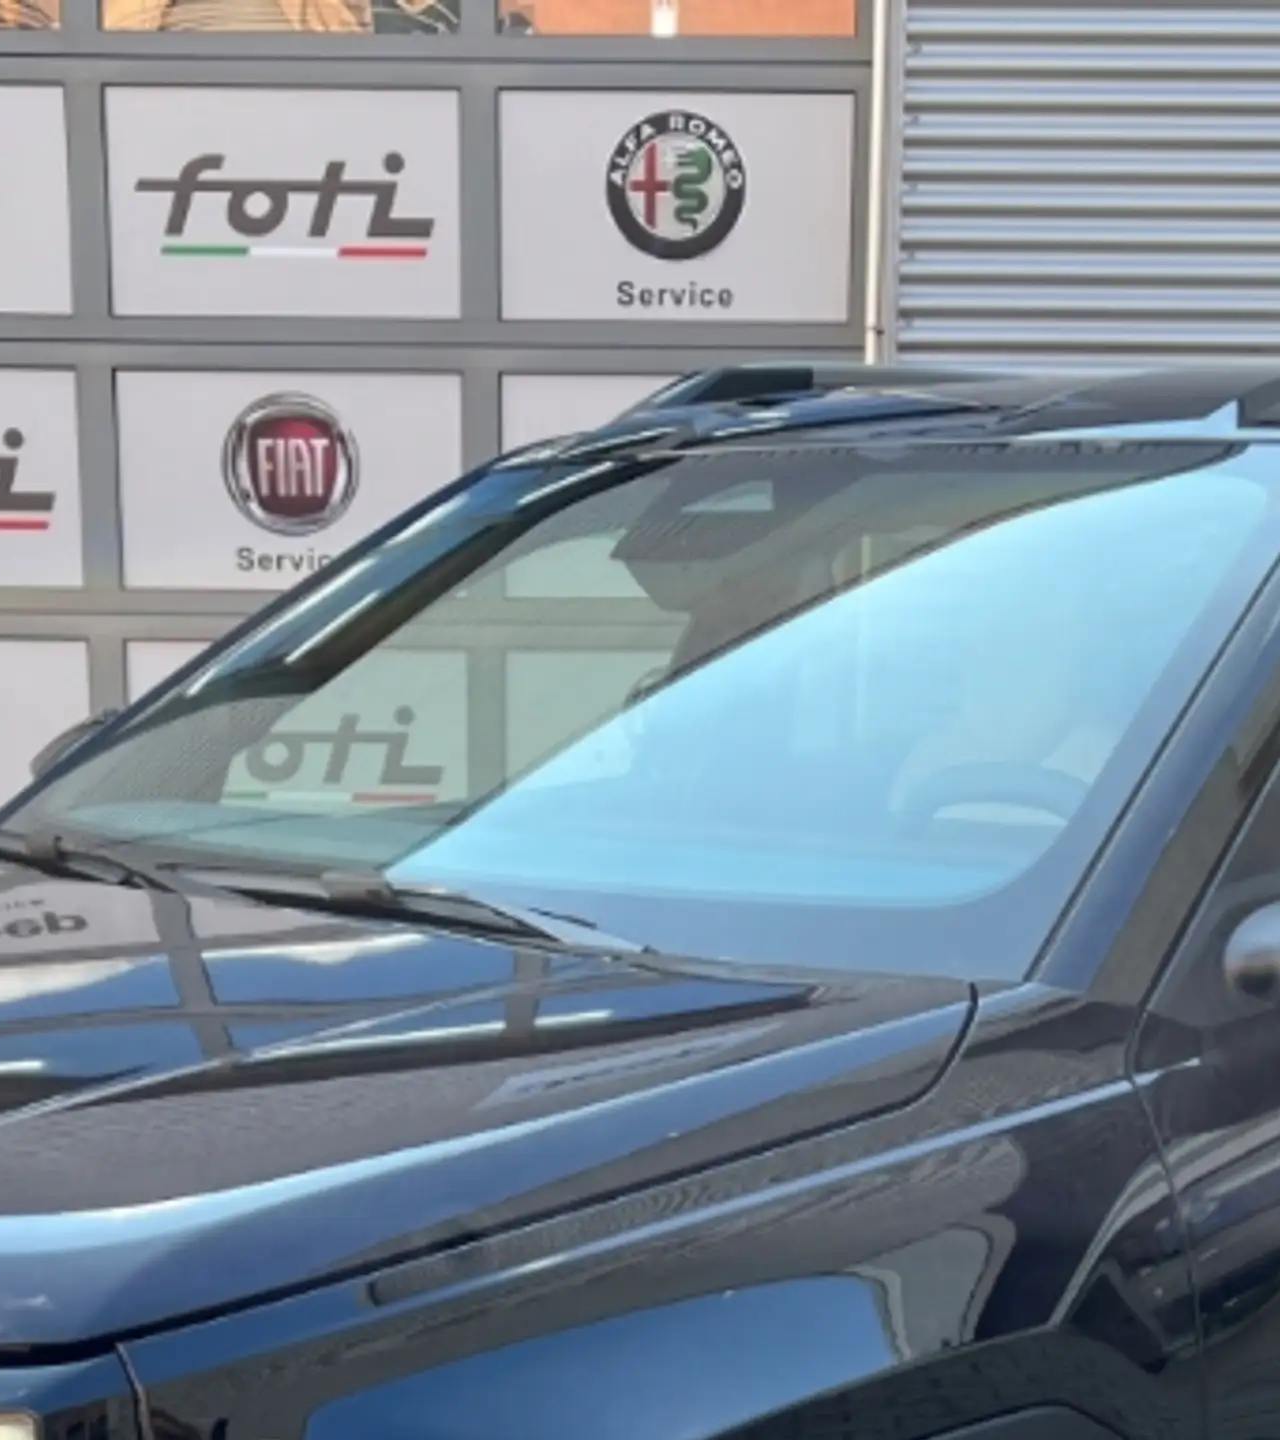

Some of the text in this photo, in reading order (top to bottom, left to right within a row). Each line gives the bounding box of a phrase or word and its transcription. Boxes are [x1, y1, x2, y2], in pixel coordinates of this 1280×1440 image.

[134, 151, 435, 238] foti
[616, 280, 734, 309] Service
[257, 438, 330, 497] FIAT
[235, 547, 332, 572] Servic
[244, 704, 444, 785] oti
